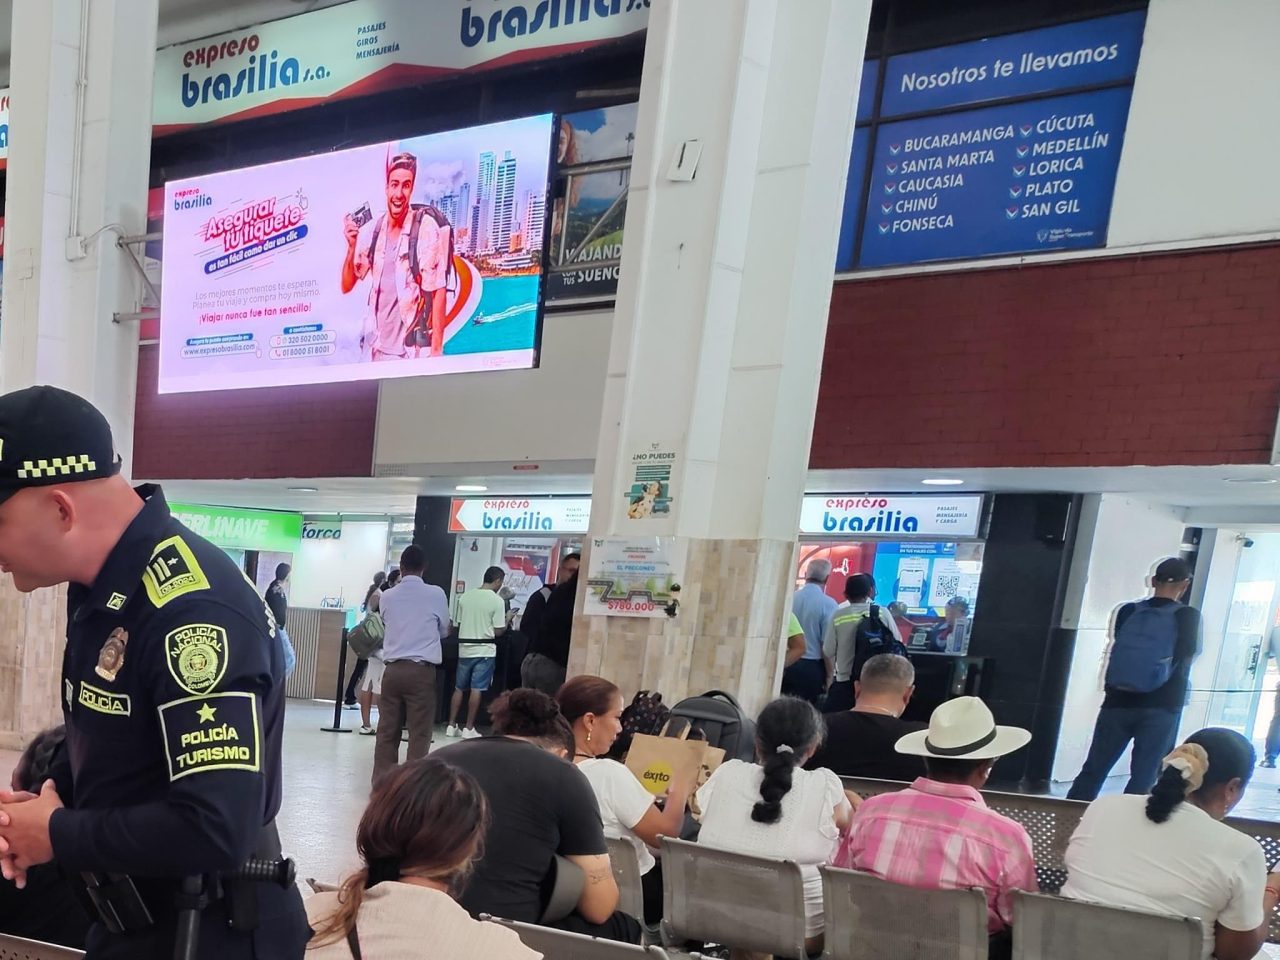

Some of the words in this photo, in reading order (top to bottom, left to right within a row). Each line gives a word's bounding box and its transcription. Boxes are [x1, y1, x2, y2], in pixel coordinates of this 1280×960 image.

[357, 21, 386, 35] PASAJES
[356, 35, 378, 47] GIROS
[356, 41, 400, 60] MENSAJERÍA
[183, 34, 260, 69] expreso
[901, 66, 986, 93] Nosotros
[993, 60, 1014, 78] te
[1020, 43, 1118, 74] llevamos
[181, 50, 299, 108] brasilia
[303, 66, 331, 82] s.a.
[1036, 113, 1095, 134] CÚCUTA
[904, 125, 1014, 153] BUCARAMANGA
[1032, 130, 1108, 157] MEDELLÍN
[901, 155, 943, 174] SANTA
[947, 150, 995, 168] MARTA
[1029, 157, 1084, 177] LORICA
[898, 174, 964, 194] CAUCASIA
[1025, 180, 1073, 197] PLATO
[175, 194, 212, 211] brasilia
[895, 193, 938, 214] CHINÚ
[1021, 203, 1050, 218] SAN
[1055, 199, 1080, 214] GIL
[204, 196, 277, 241] Asegurar
[892, 215, 954, 233] FONSECA
[224, 230, 243, 251] tu
[243, 206, 302, 244] tiquete
[244, 245, 262, 259] como
[195, 290, 207, 300] Los
[208, 288, 236, 300] mejores
[237, 283, 276, 296] momentos
[277, 282, 285, 291] te
[563, 277, 575, 286] TUS
[249, 293, 277, 306] compra
[278, 291, 291, 302] hoy
[225, 311, 247, 321] nunca
[249, 308, 262, 318] fue
[264, 307, 277, 316] tan
[279, 302, 312, 315] sencillo!
[288, 336, 300, 344] 320
[649, 452, 675, 460] PUEDES
[484, 500, 530, 511] expreso
[826, 498, 888, 511] expreso
[482, 511, 553, 530] brasilia
[823, 510, 918, 532] brasilia
[175, 627, 217, 642] POLICÍA
[171, 636, 222, 657] NACIONAL
[82, 689, 124, 711] POLICÍA
[180, 723, 239, 748] POLICÍA
[176, 746, 250, 768] TURISMO
[643, 770, 670, 783] éxito
